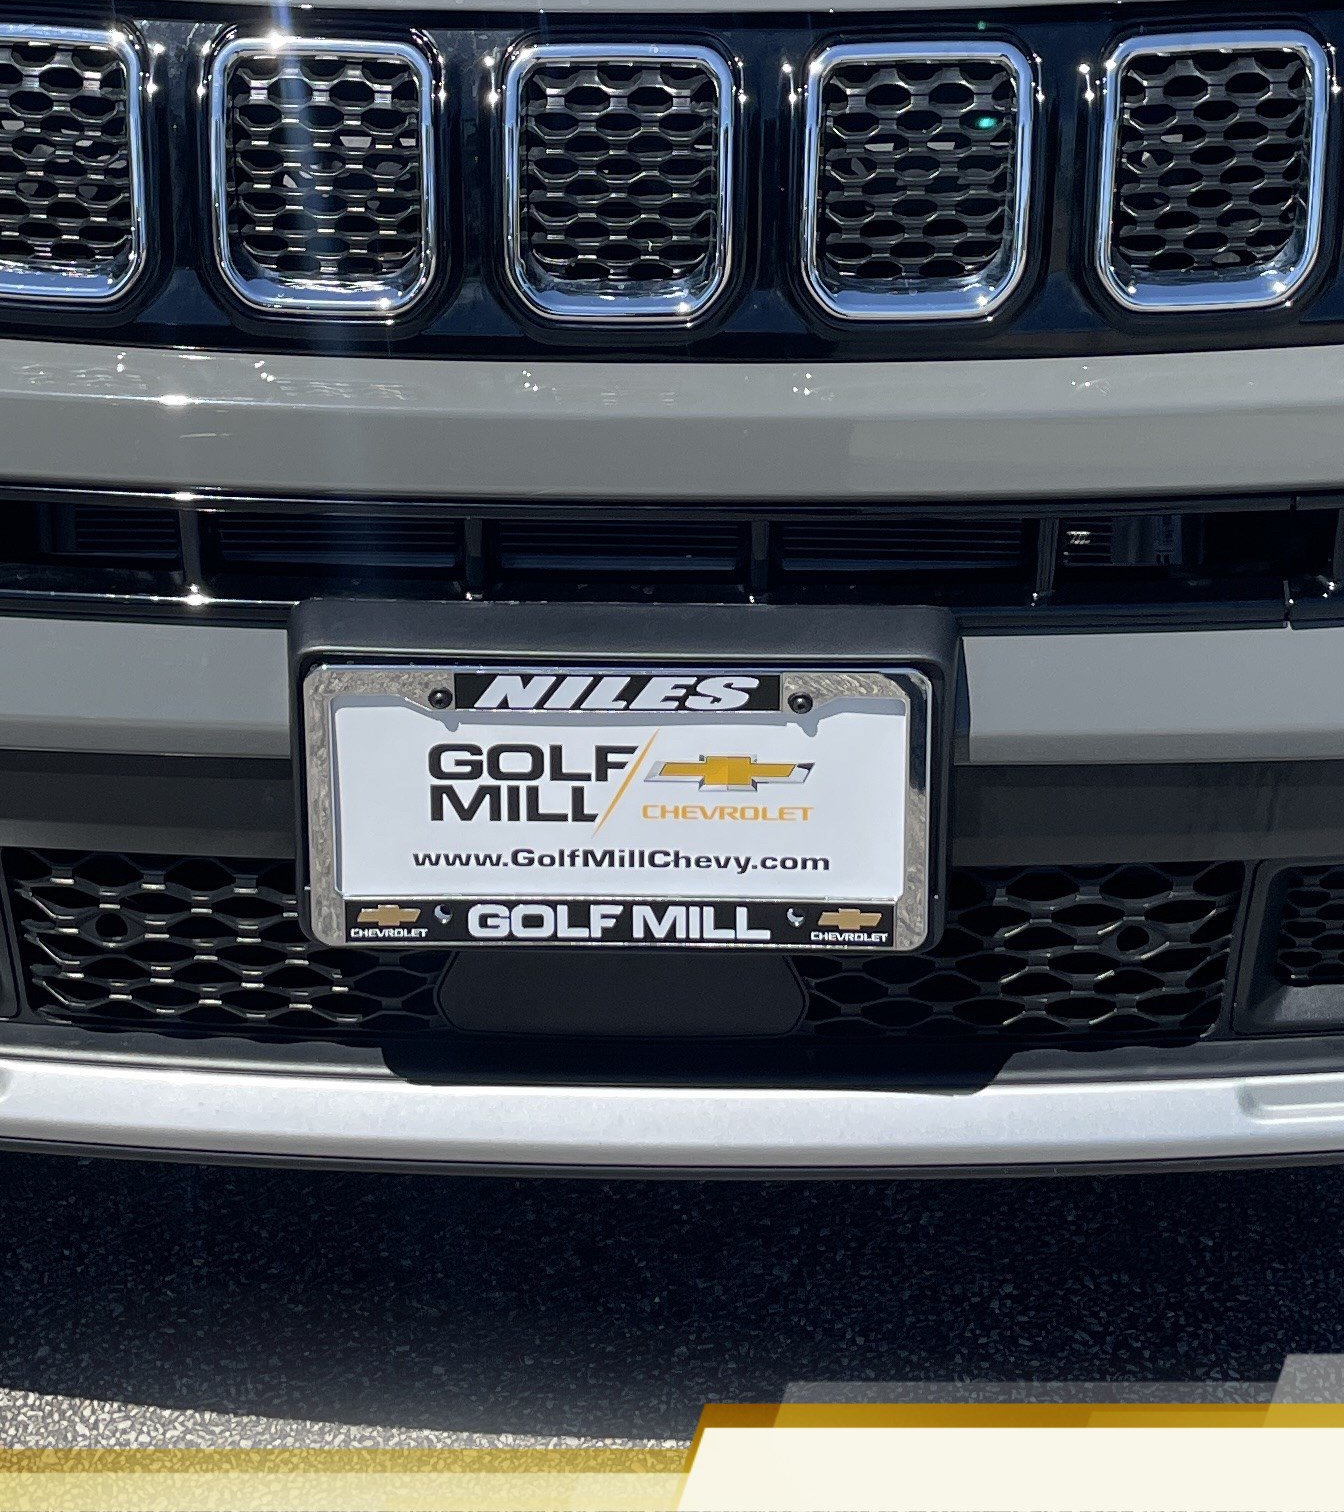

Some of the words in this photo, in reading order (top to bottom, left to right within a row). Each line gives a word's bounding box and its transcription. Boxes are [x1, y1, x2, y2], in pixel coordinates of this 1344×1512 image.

[473, 675, 760, 710] NILES
[428, 743, 640, 783] GOLF
[429, 783, 600, 823] MILL
[641, 804, 814, 822] CHEVROLET
[412, 848, 830, 875] www.GolfMillChevy.com
[350, 927, 429, 938] CHEVROLET
[467, 903, 624, 939] GOLF
[632, 904, 771, 940] MILL
[810, 931, 888, 943] CHEVROLET
